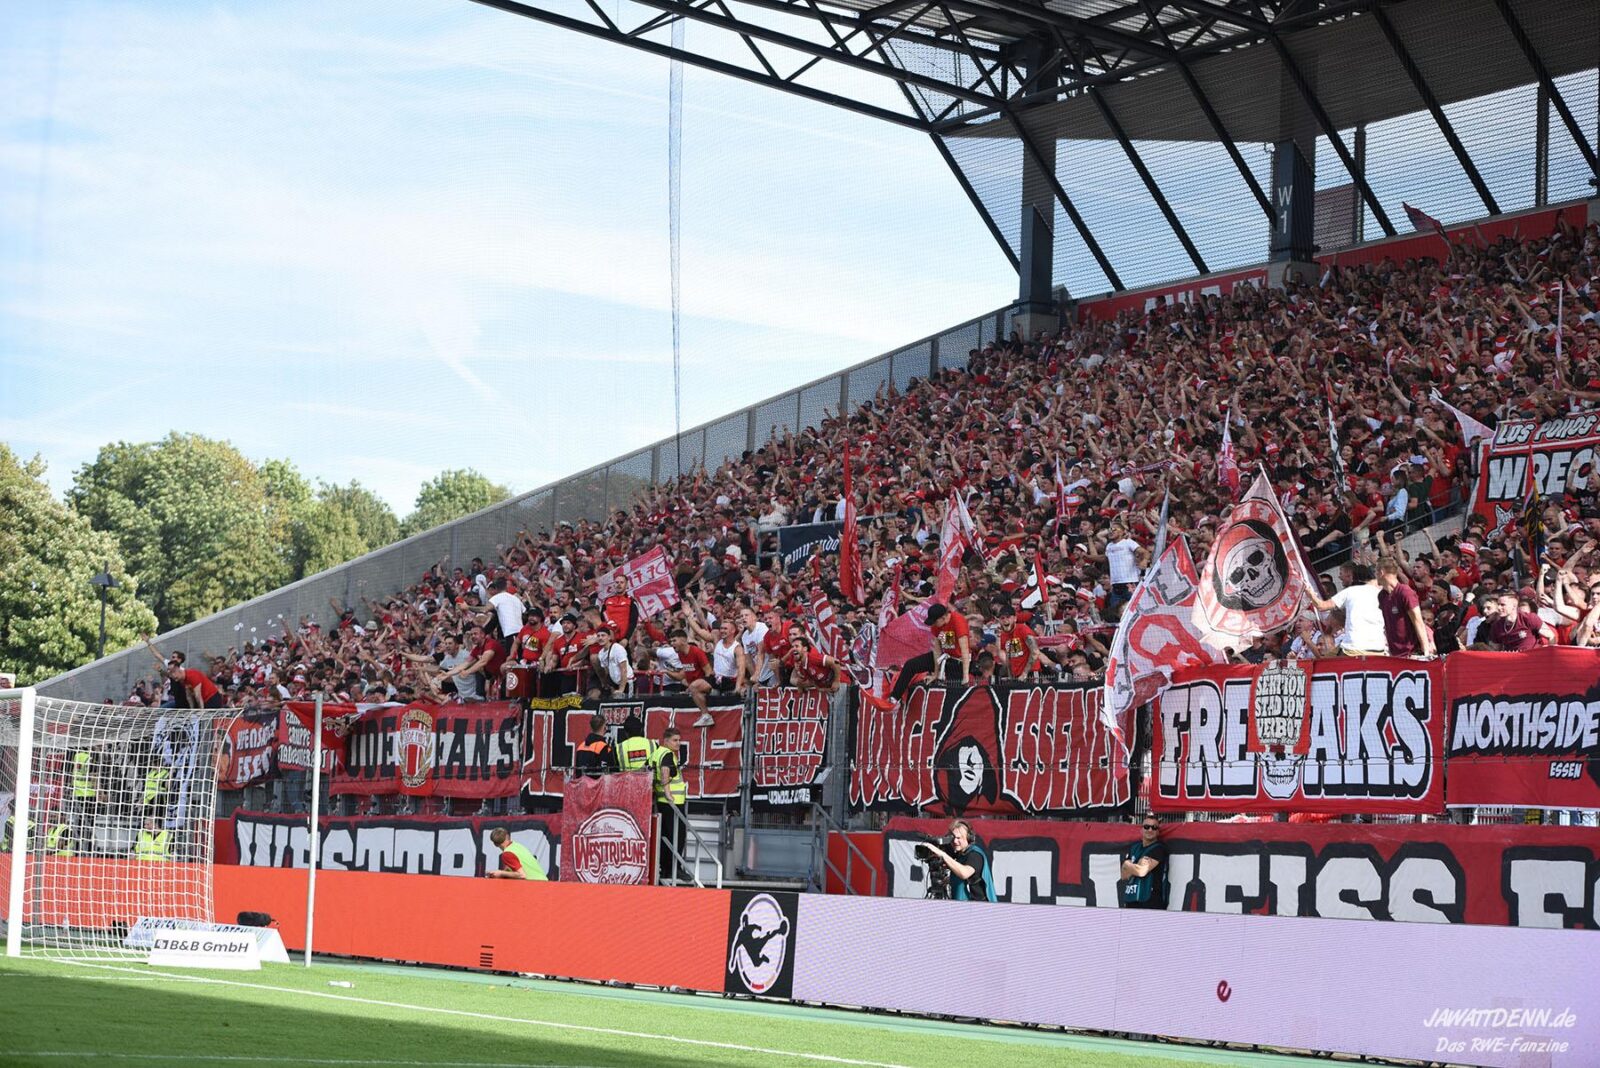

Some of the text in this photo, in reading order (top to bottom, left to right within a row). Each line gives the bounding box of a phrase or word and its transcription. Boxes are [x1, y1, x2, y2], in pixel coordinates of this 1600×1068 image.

[1278, 184, 1293, 207] W
[1280, 210, 1288, 234] 1
[1494, 423, 1535, 445] LOS
[1487, 448, 1600, 499] WREC
[1255, 673, 1306, 695] SEKTION
[756, 687, 829, 720] SEKTION
[1255, 695, 1304, 717] STADION
[754, 720, 828, 754] STADION
[1159, 671, 1432, 800] FREAKS
[1256, 717, 1303, 739] VERBOT
[1452, 700, 1600, 751] NORTHSIDE
[432, 717, 521, 781] FANS
[754, 754, 823, 787] VERBOT
[1549, 762, 1583, 778] ESSEN
[237, 820, 560, 884] WESTTRI
[888, 838, 1600, 930] RT-WEISS E
[169, 940, 249, 953] B&B GmbH
